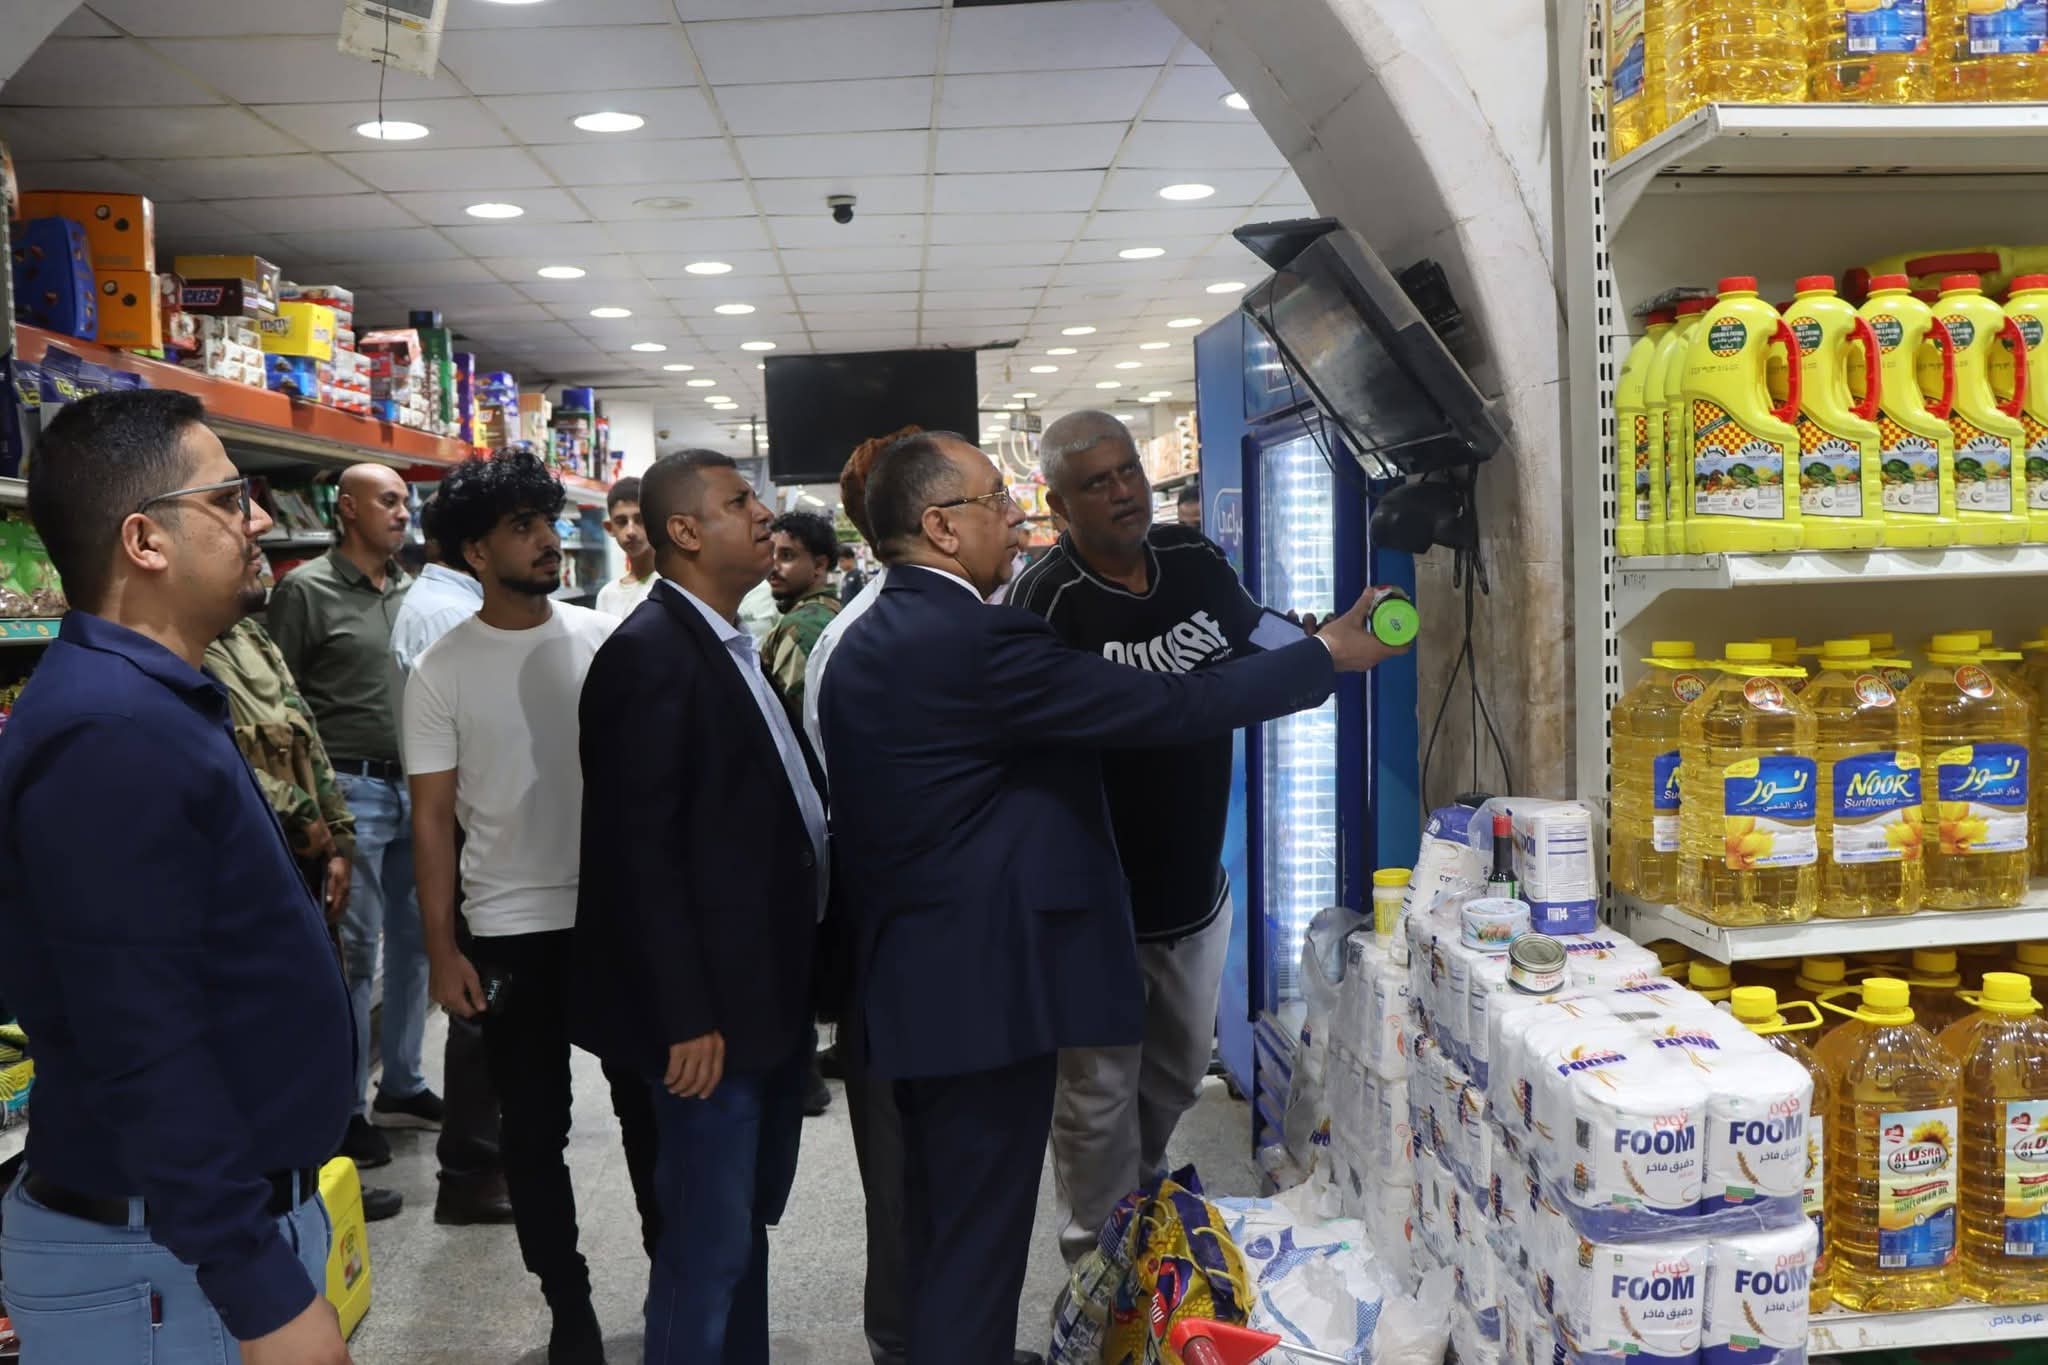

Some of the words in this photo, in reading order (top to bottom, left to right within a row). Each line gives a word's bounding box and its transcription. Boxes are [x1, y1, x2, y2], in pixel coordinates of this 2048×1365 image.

[1740, 441, 1776, 456] HAYAT
[1817, 440, 1852, 454] HAYAT
[1895, 438, 1930, 451] HAYAT
[1967, 436, 2002, 450] HAYAT
[1951, 756, 2020, 793] نور
[1735, 768, 1809, 806] نور
[1846, 769, 1915, 798] NOOR
[1844, 797, 1898, 809] Sunflower
[1652, 1035, 1721, 1050] FOOM
[1557, 1053, 1627, 1077] FOOM
[1767, 1093, 1800, 1121] فوم
[1652, 1107, 1689, 1132] فوم
[1729, 1113, 1804, 1146] FOOM
[1614, 1125, 1695, 1155] FOOM
[1760, 1151, 1780, 1164] فاخر
[1894, 1146, 1941, 1163] ALOSRA
[1646, 1162, 1668, 1175] فاخر
[1669, 1159, 1695, 1173] دقيق
[1611, 1274, 1695, 1302] FOOM
[1735, 1265, 1808, 1296] FOOM
[1643, 1308, 1665, 1320] فاخر
[1666, 1307, 1694, 1320] دقيق
